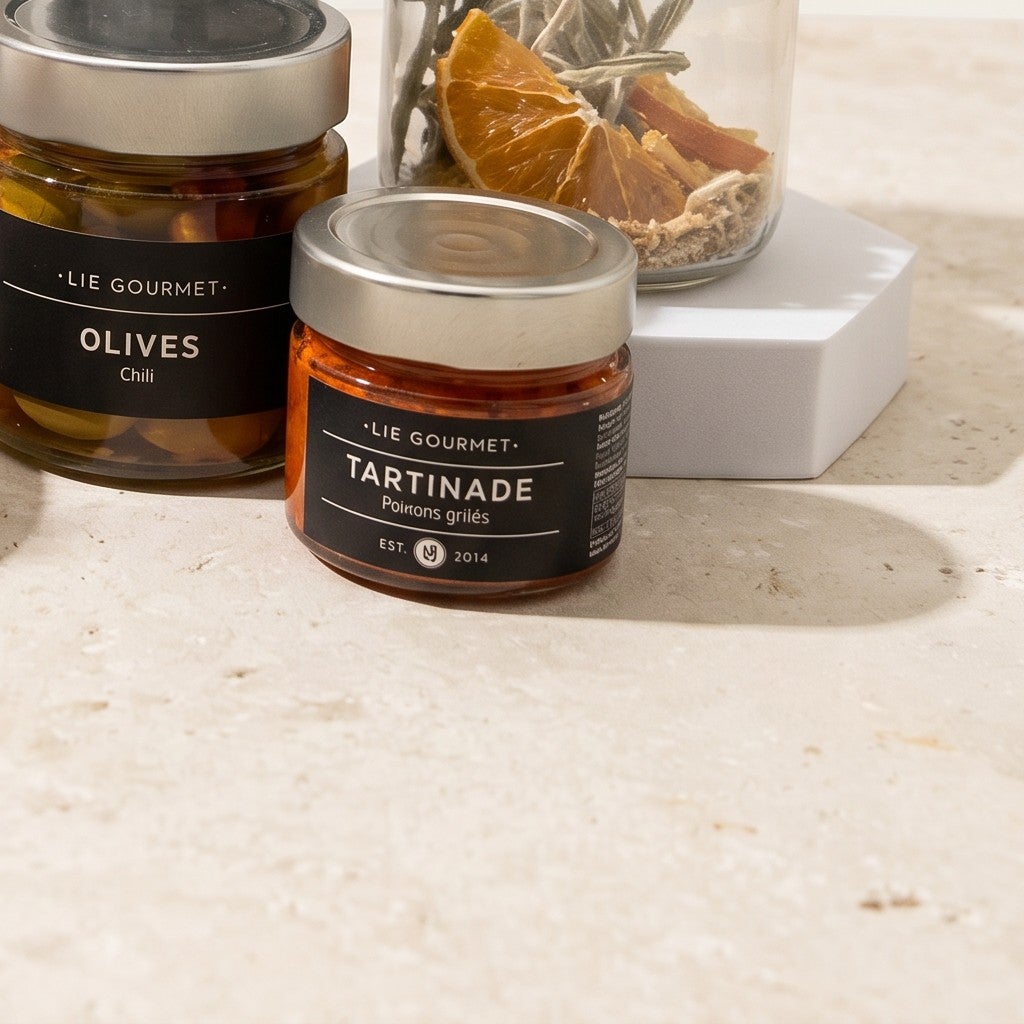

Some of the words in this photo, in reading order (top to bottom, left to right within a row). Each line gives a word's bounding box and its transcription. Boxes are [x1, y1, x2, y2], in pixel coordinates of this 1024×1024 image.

[80, 327, 200, 359] OLIVES
[120, 367, 154, 383] Chili
[347, 453, 533, 503] TARTINADE
[446, 508, 490, 526] grilés
[379, 538, 407, 554] EST.
[454, 551, 488, 563] 2014
